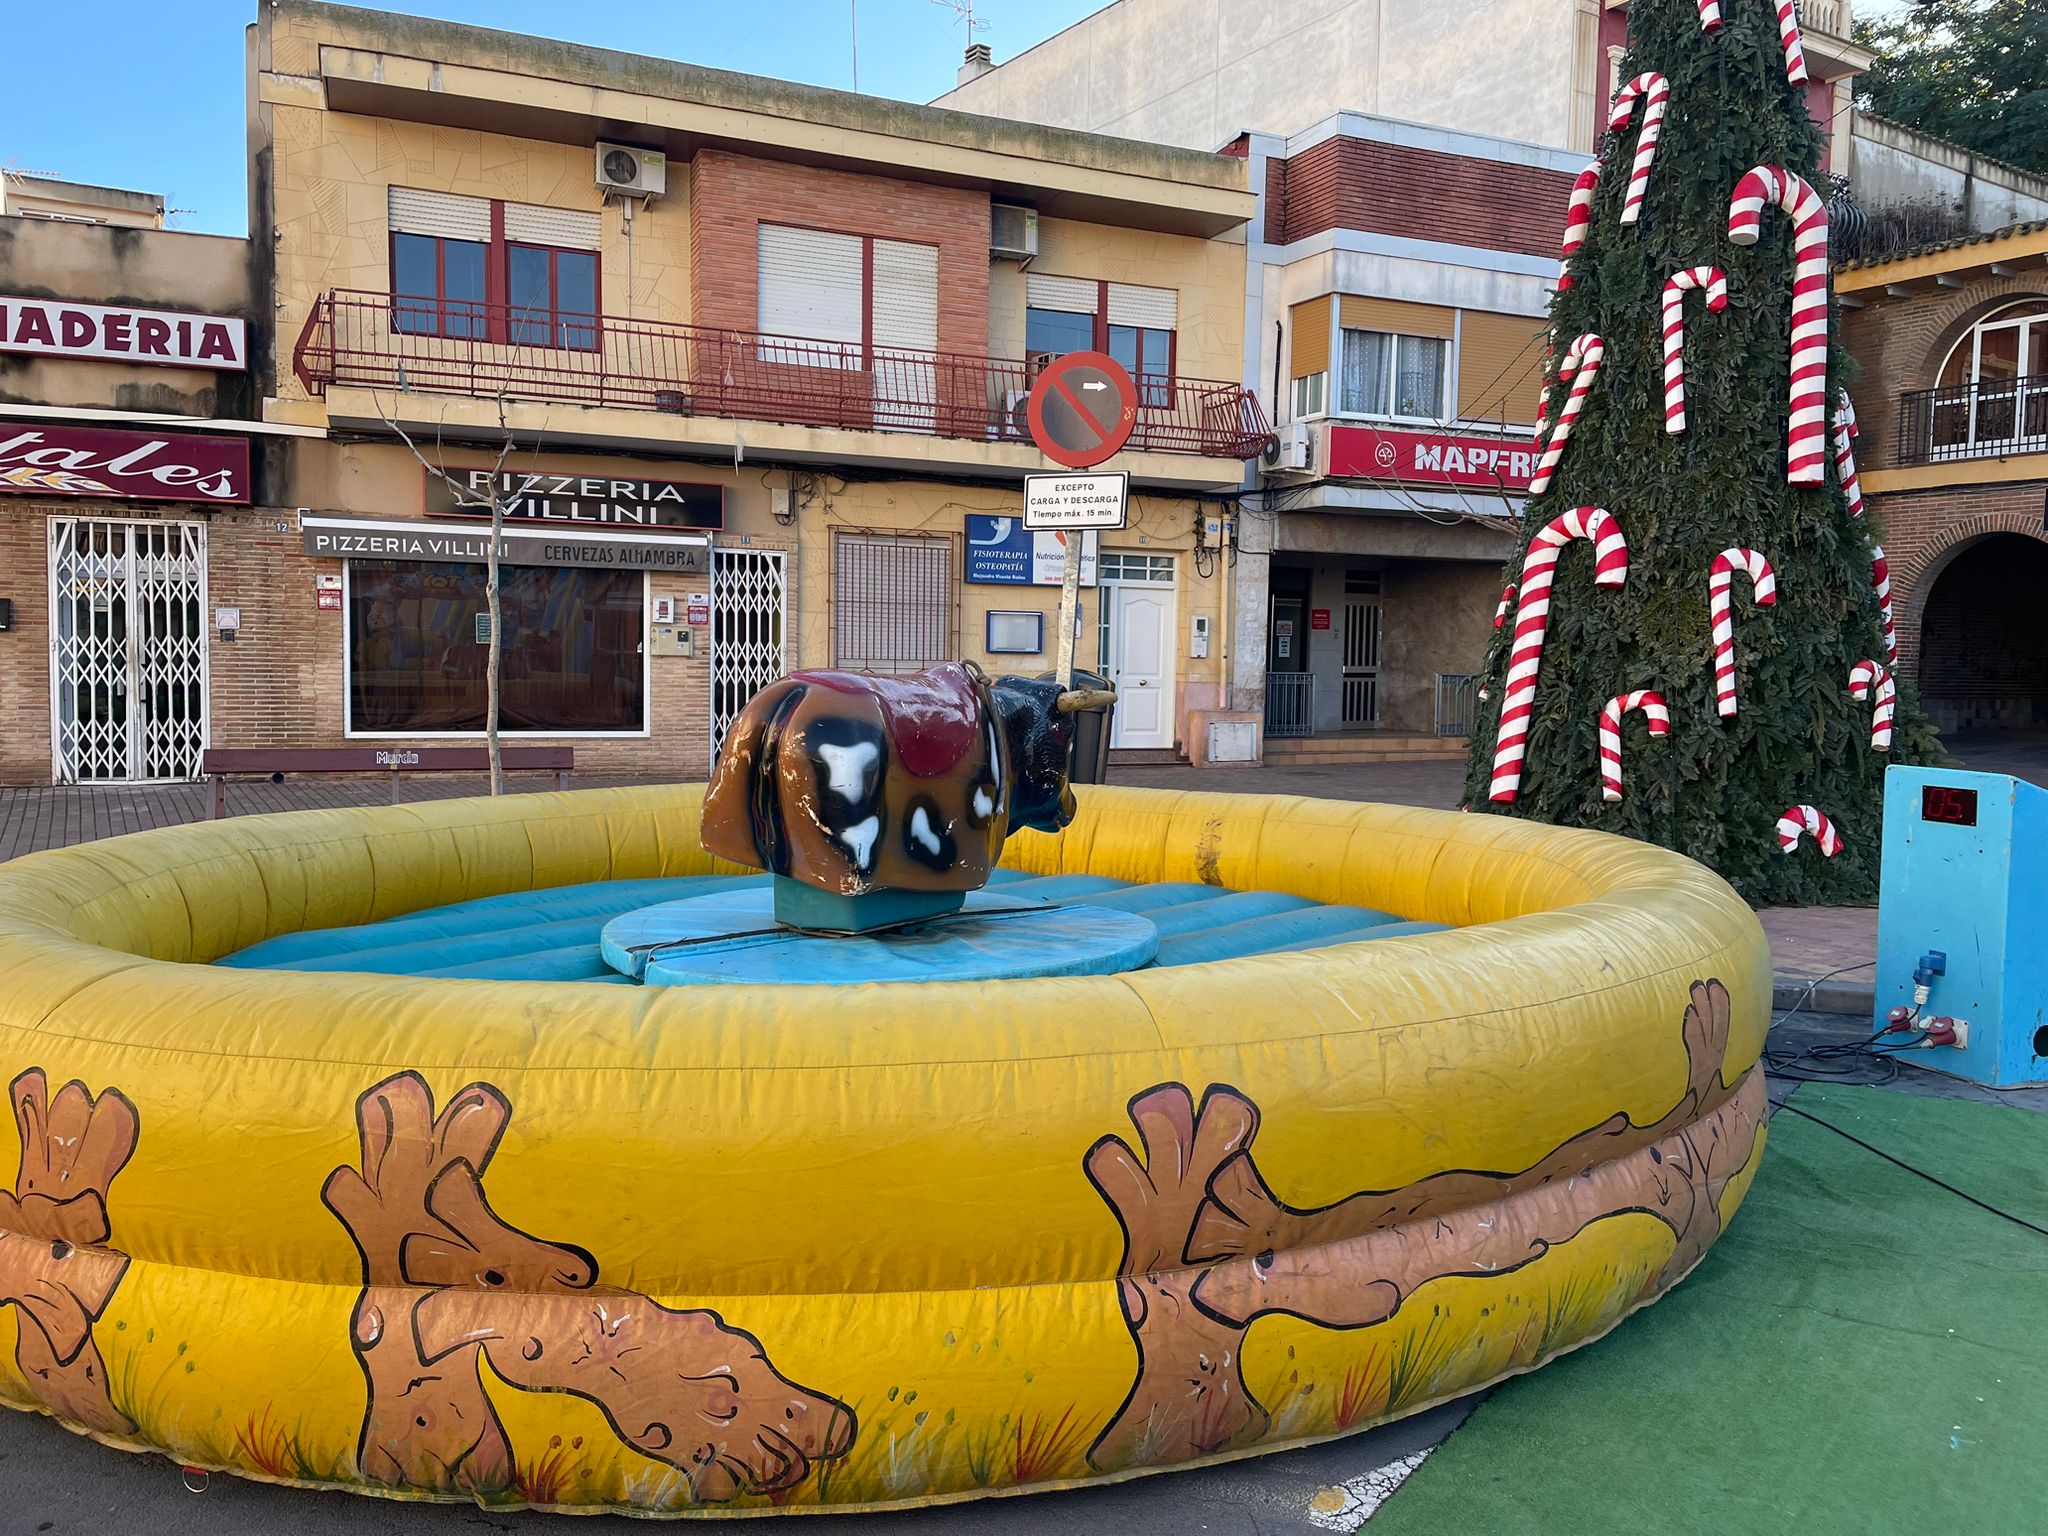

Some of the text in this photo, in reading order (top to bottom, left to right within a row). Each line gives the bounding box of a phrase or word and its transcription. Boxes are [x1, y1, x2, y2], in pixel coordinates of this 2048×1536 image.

[0, 305, 237, 361] ADERIA
[469, 470, 686, 503] PIZZERIA
[1055, 483, 1094, 492] EXCEPTO
[1030, 497, 1060, 505] CARGA
[1071, 496, 1118, 504] DESCARGA
[496, 498, 657, 525] VILLINI
[1033, 510, 1062, 519] Tiempo
[277, 522, 288, 532] 12
[316, 535, 424, 554] PIZZERIA
[544, 545, 695, 566] CERVEZAS ALHAMBRA
[973, 549, 1028, 560] FISIOTERAPIA
[1035, 551, 1065, 561] Nutrición
[975, 560, 1024, 571] OSTEOPATÍA
[376, 750, 419, 764] Murcia
